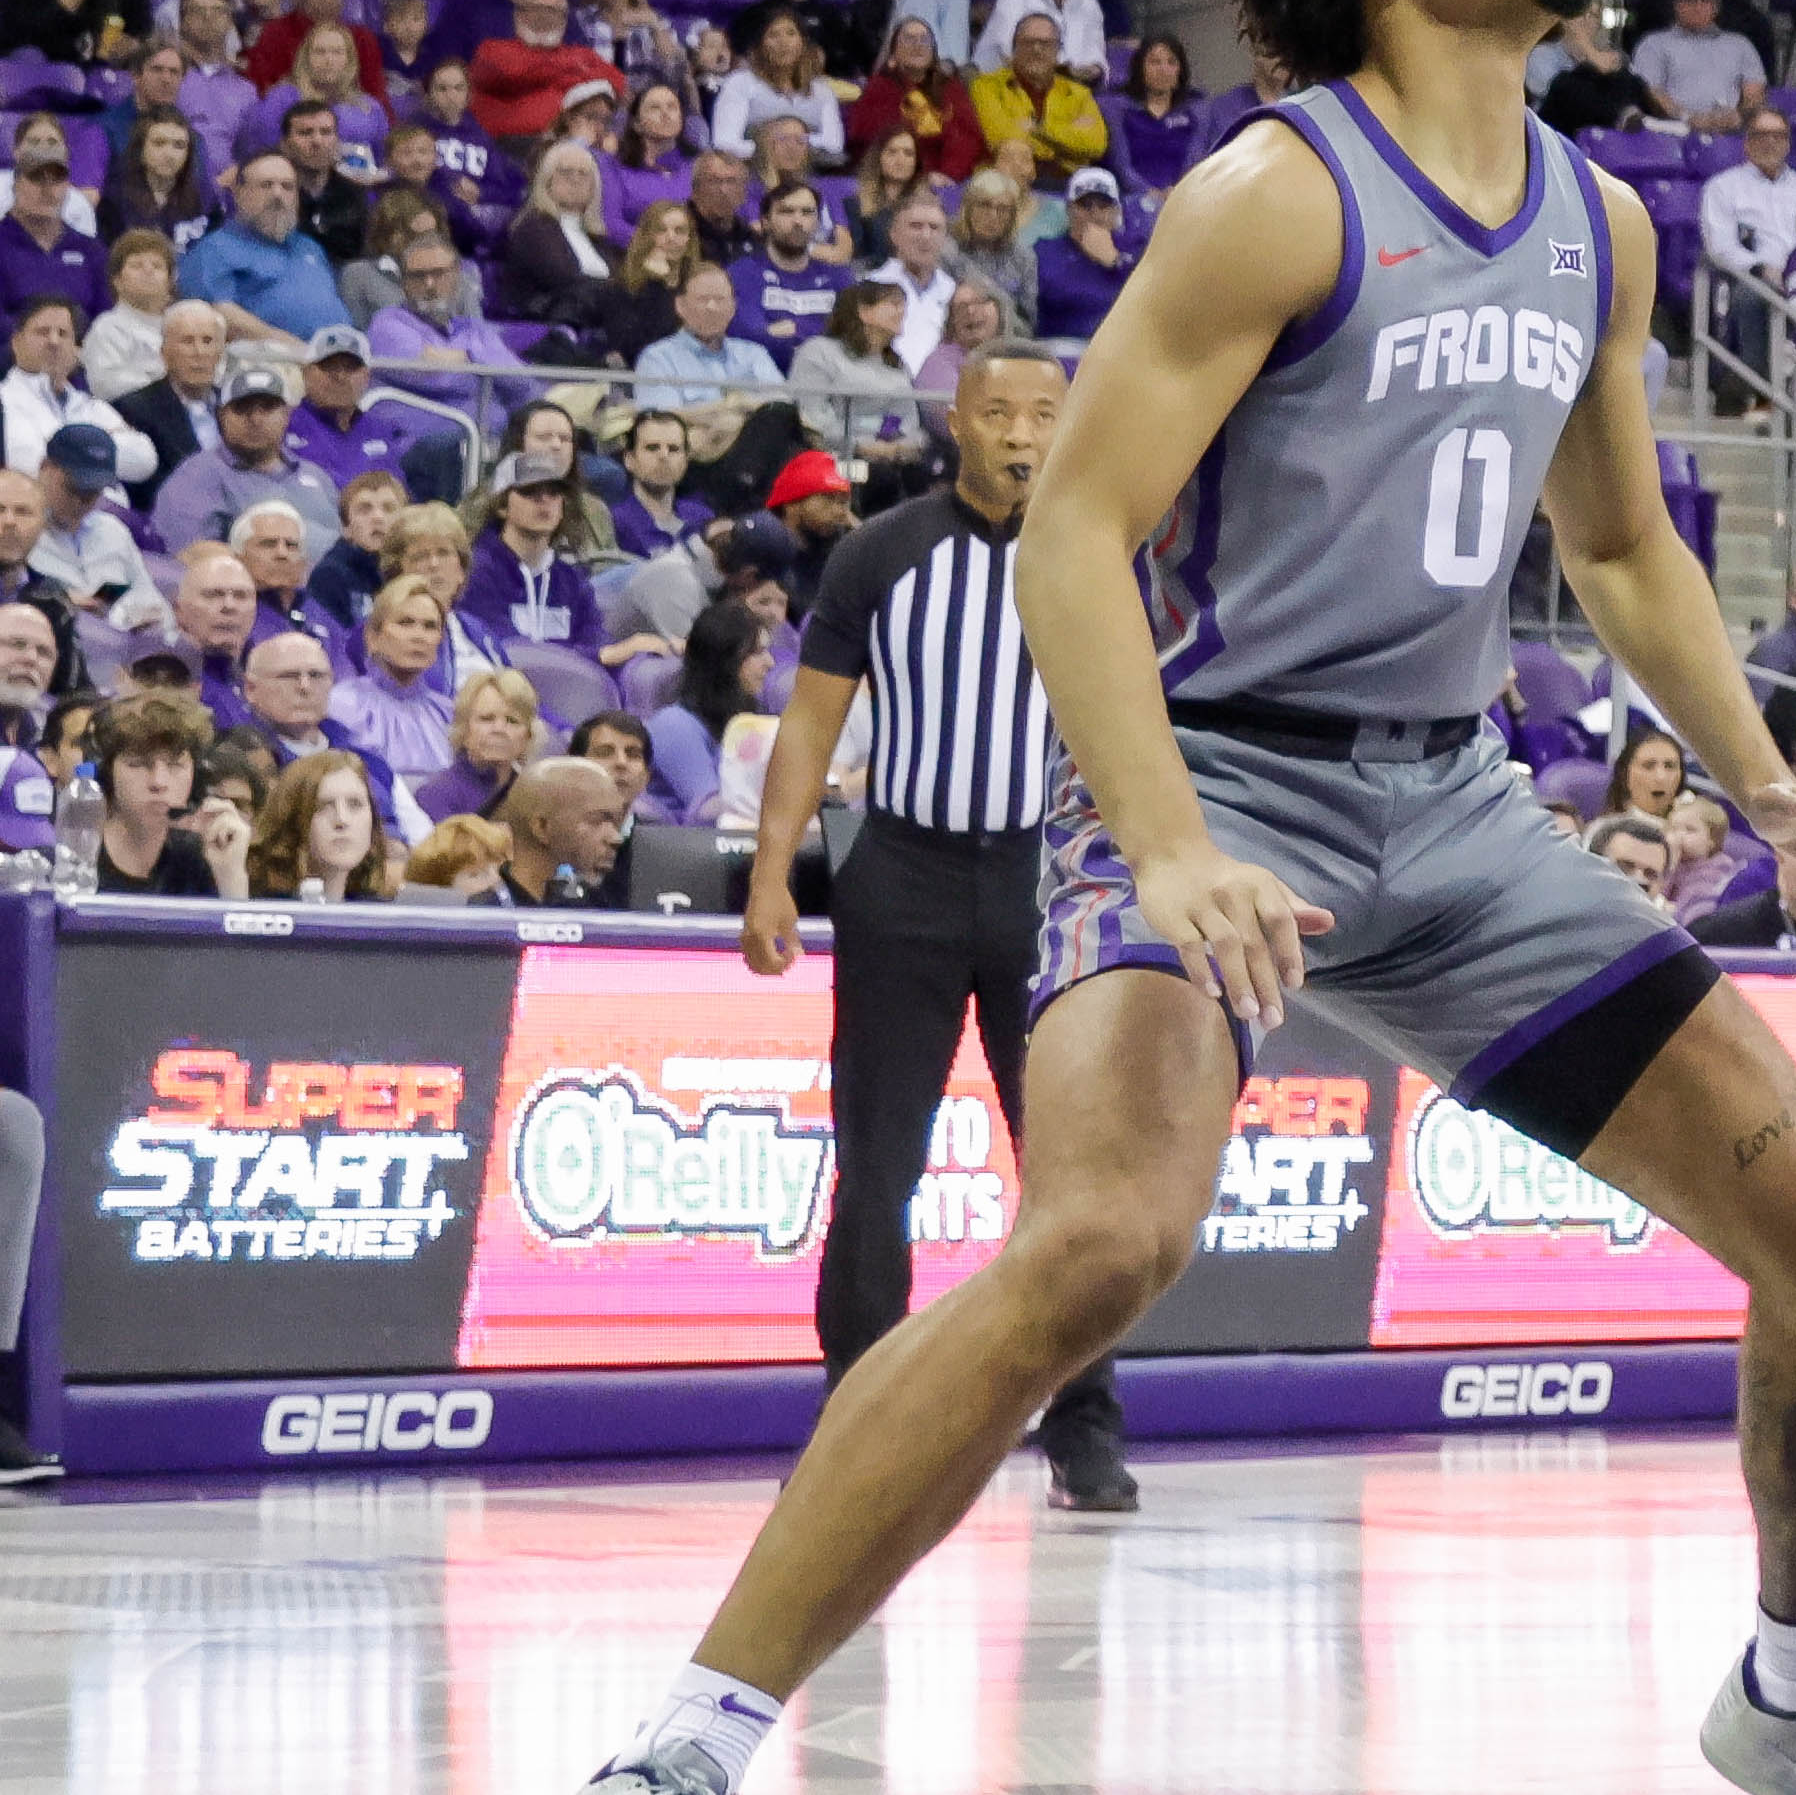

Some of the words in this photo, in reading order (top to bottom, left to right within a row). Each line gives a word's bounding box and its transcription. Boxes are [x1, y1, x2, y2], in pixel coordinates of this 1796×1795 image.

[1366, 304, 1583, 405] FROGS
[1423, 427, 1512, 588] 0
[148, 1046, 464, 1130] SUPER
[100, 1116, 468, 1210] START
[519, 1080, 829, 1252] O'Reilly
[136, 1218, 418, 1259] BATTERIES
[1203, 1214, 1341, 1251] TERIES
[262, 1390, 494, 1455] GEICO
[1441, 1362, 1613, 1418] GEICO
